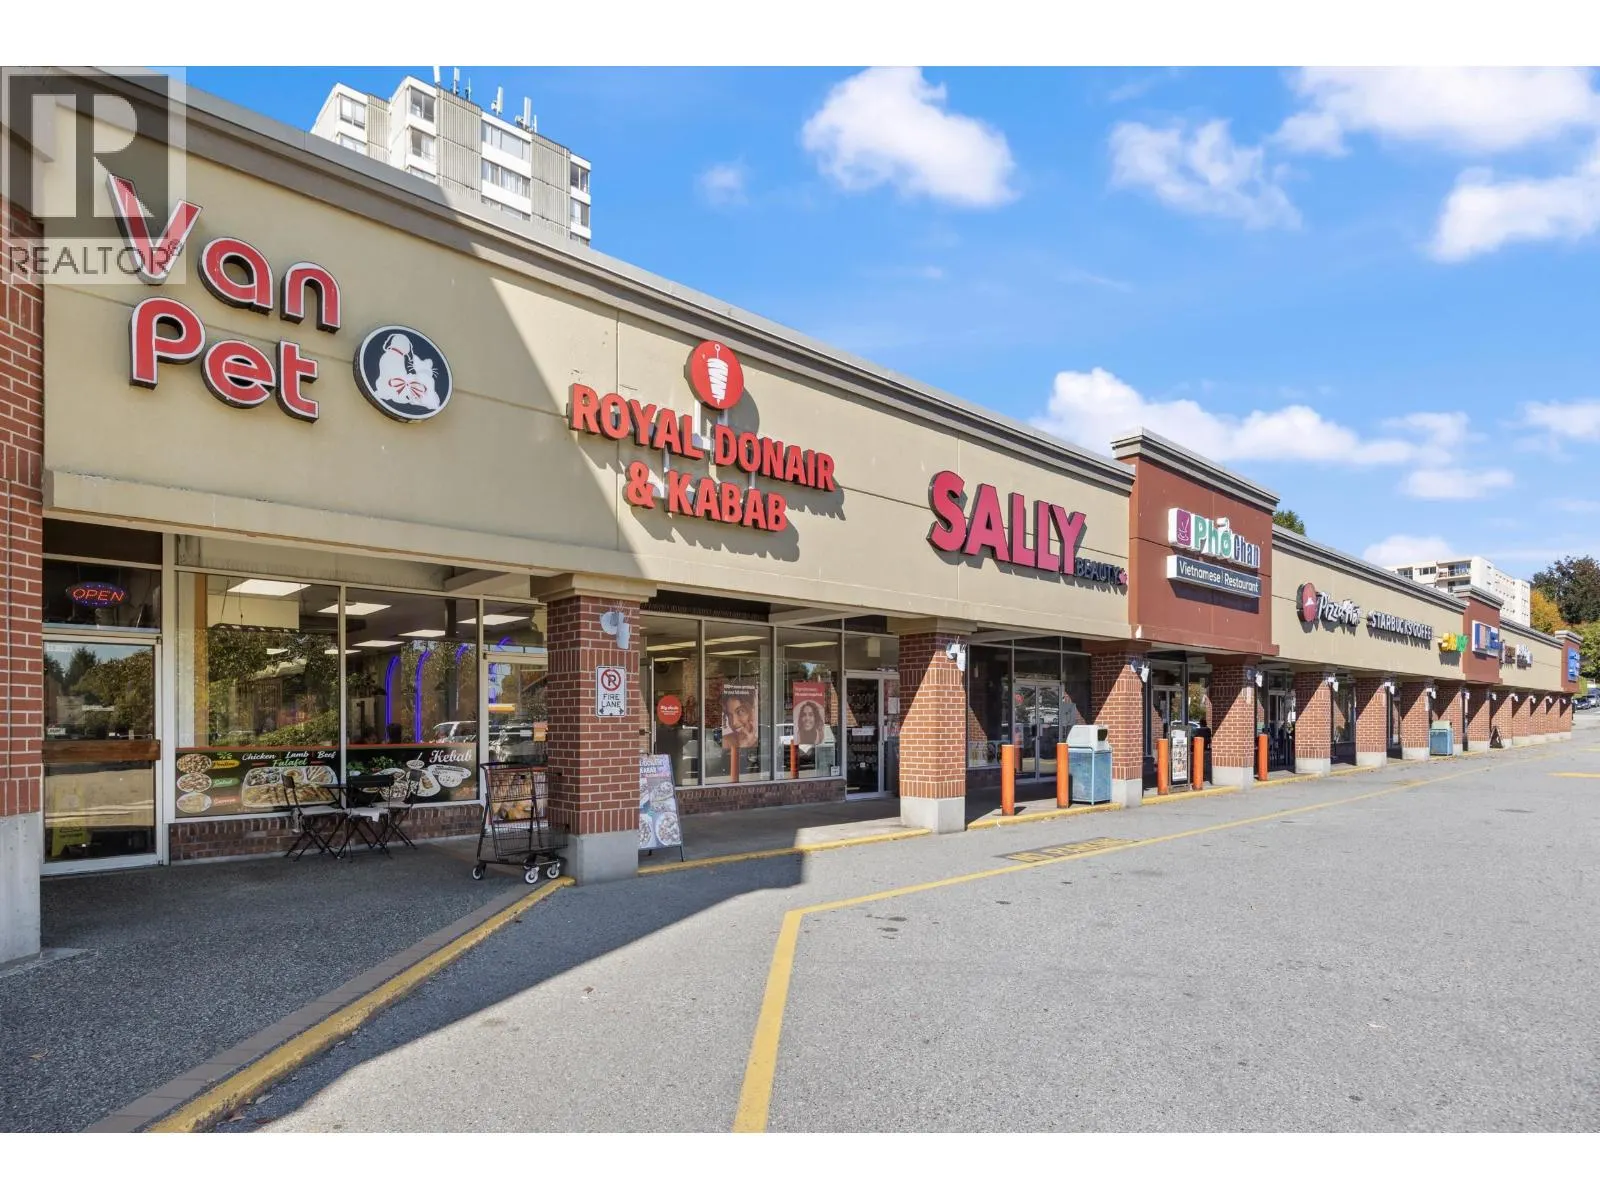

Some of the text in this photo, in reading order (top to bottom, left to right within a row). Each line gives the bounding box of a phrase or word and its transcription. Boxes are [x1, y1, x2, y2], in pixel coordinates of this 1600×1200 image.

[107, 172, 341, 333] Van
[130, 297, 320, 422] Pet
[568, 383, 836, 492] ROYAL DONAIR
[623, 460, 787, 532] & KABAB
[927, 470, 1086, 576] SALLY
[1075, 557, 1121, 585] BEAUTY
[1179, 560, 1259, 593] Vietnamese Restaurant
[73, 588, 124, 601] OPEN
[1371, 612, 1412, 636] STARBUCKS
[603, 693, 620, 701] FIRE
[241, 750, 336, 761] Chicken Lamb Beef
[272, 758, 308, 768] Falafel
[429, 749, 472, 763] Kebab
